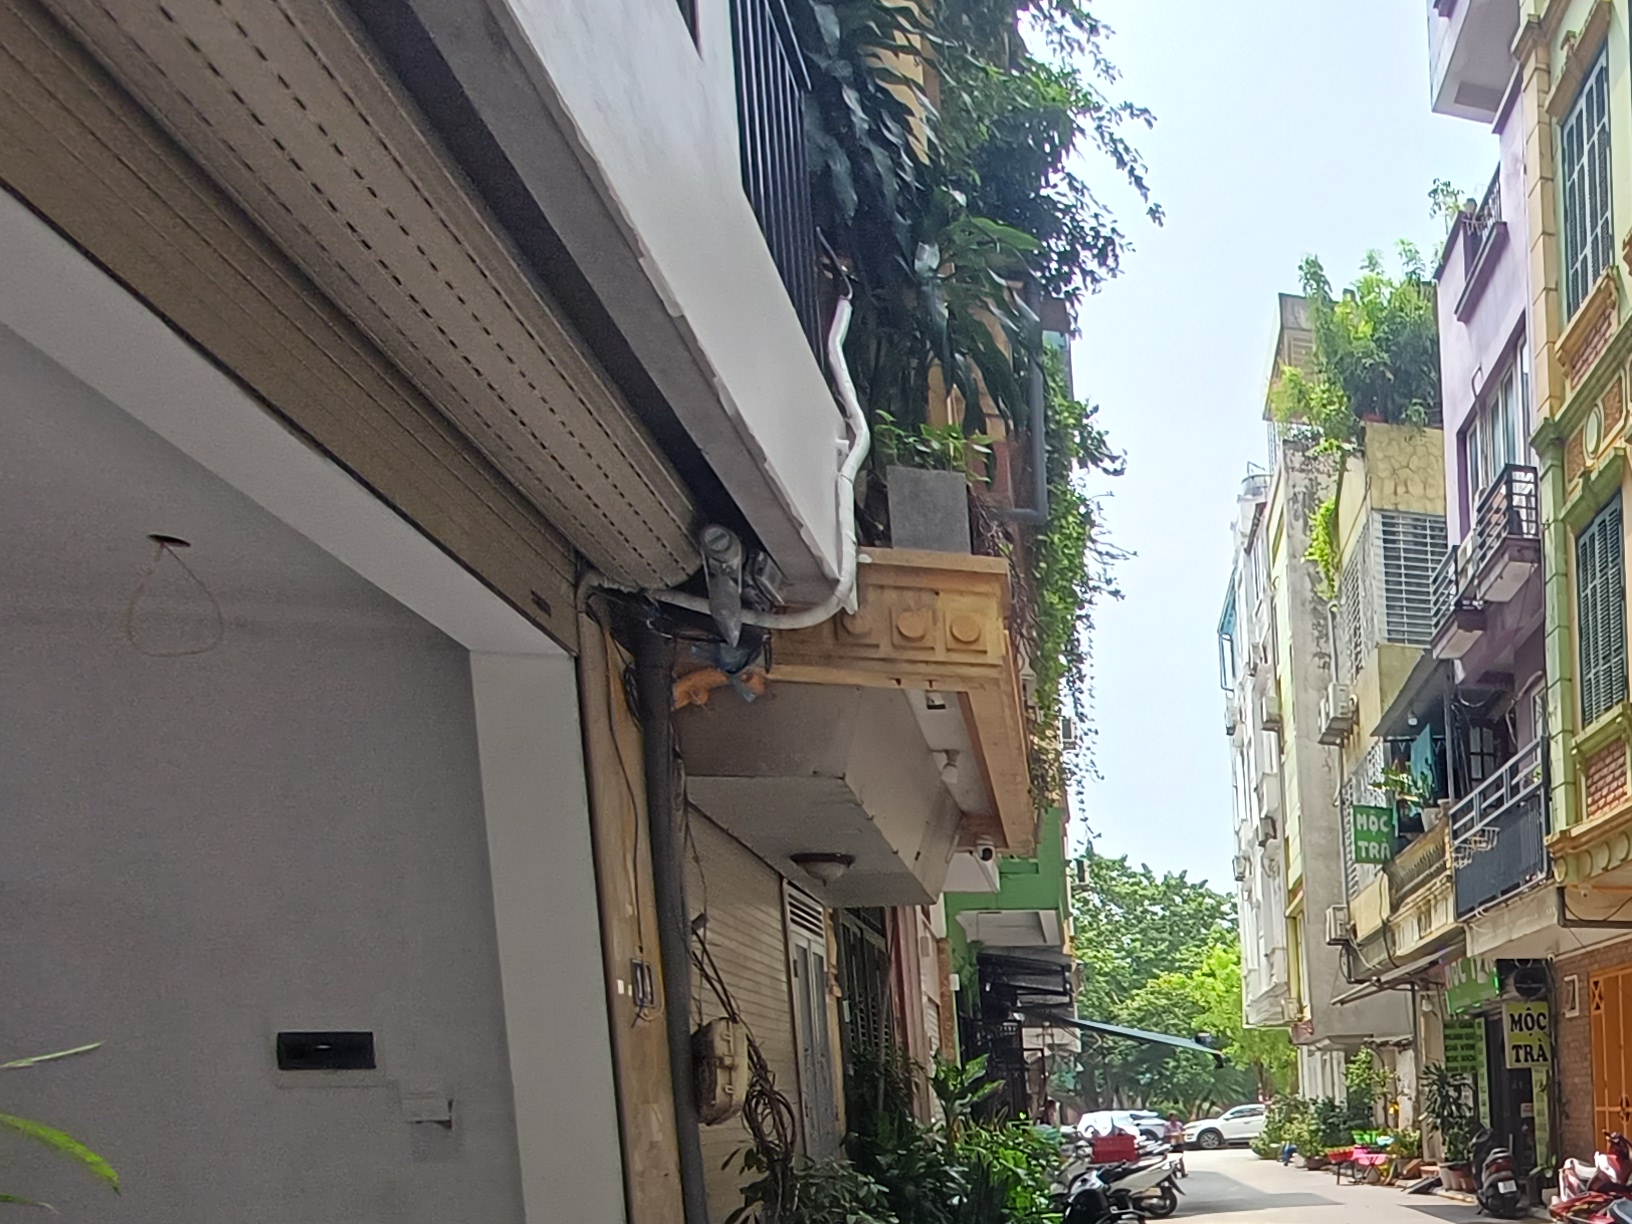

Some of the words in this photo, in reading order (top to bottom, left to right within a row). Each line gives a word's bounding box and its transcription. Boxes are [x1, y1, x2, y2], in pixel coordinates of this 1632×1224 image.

[1356, 810, 1390, 836] MỘC
[1357, 838, 1391, 860] TRÀ
[1509, 1007, 1547, 1037] MỘC
[1512, 1038, 1549, 1063] TRÀ
